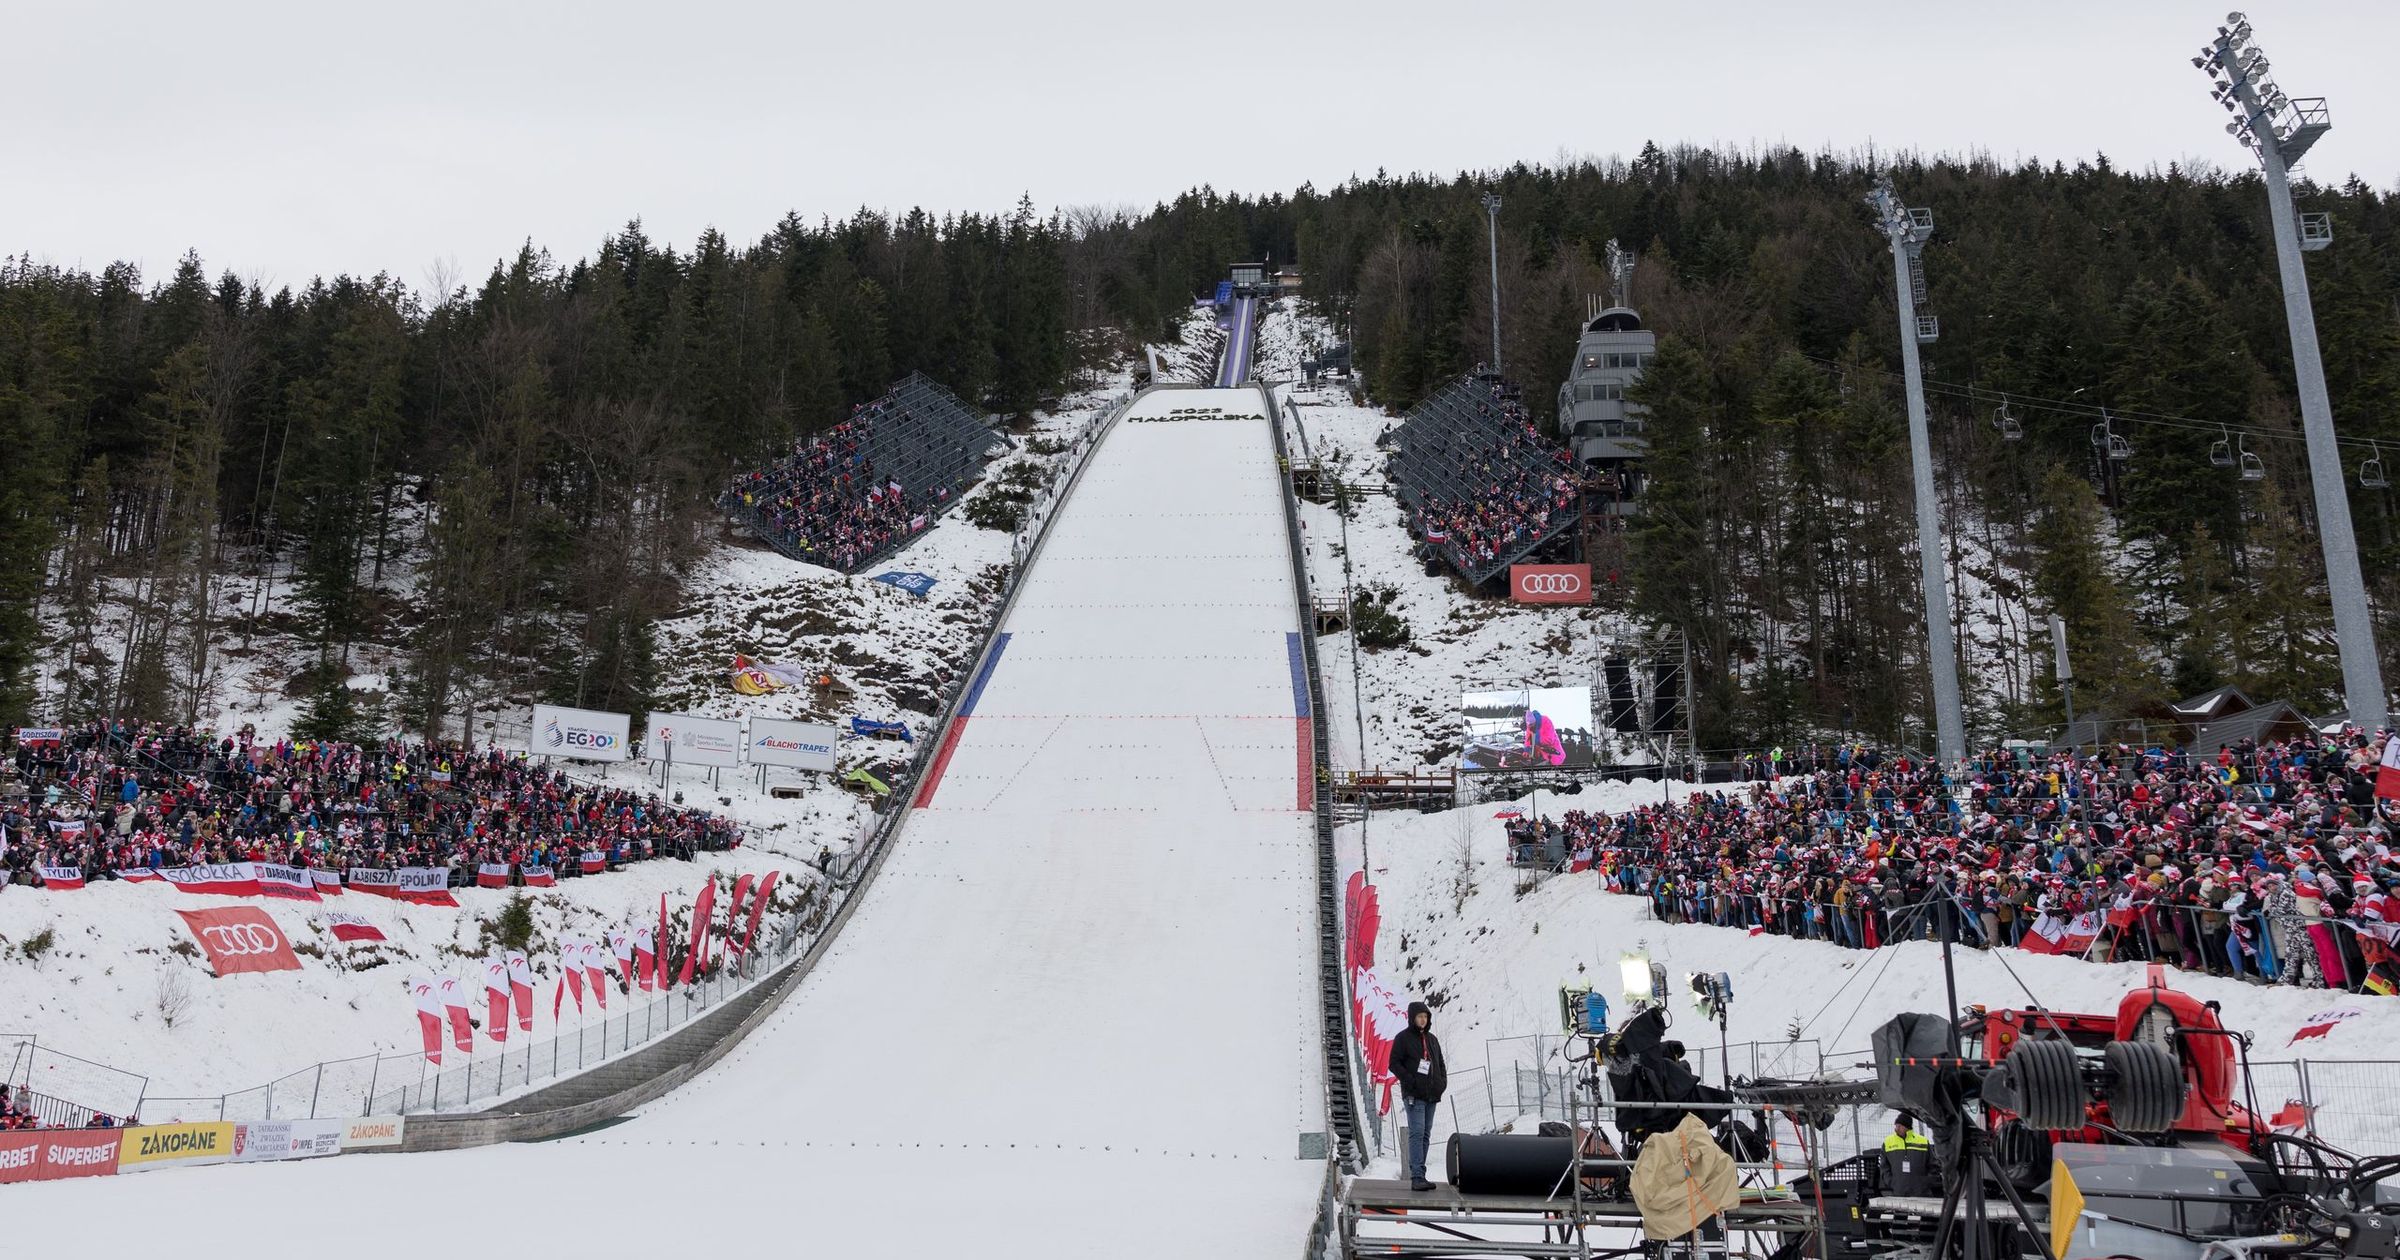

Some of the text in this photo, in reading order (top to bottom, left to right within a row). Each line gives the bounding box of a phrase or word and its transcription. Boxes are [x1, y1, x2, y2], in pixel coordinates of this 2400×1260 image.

[1127, 413, 1265, 423] MAŁOPOLSKA
[766, 738, 830, 753] BLACHOTRAPEZ
[141, 1128, 217, 1156] ZAKOPANE
[350, 1123, 396, 1140] ZAKOPANE
[0, 1144, 39, 1169] RBET
[47, 1141, 118, 1166] SUPERBET
